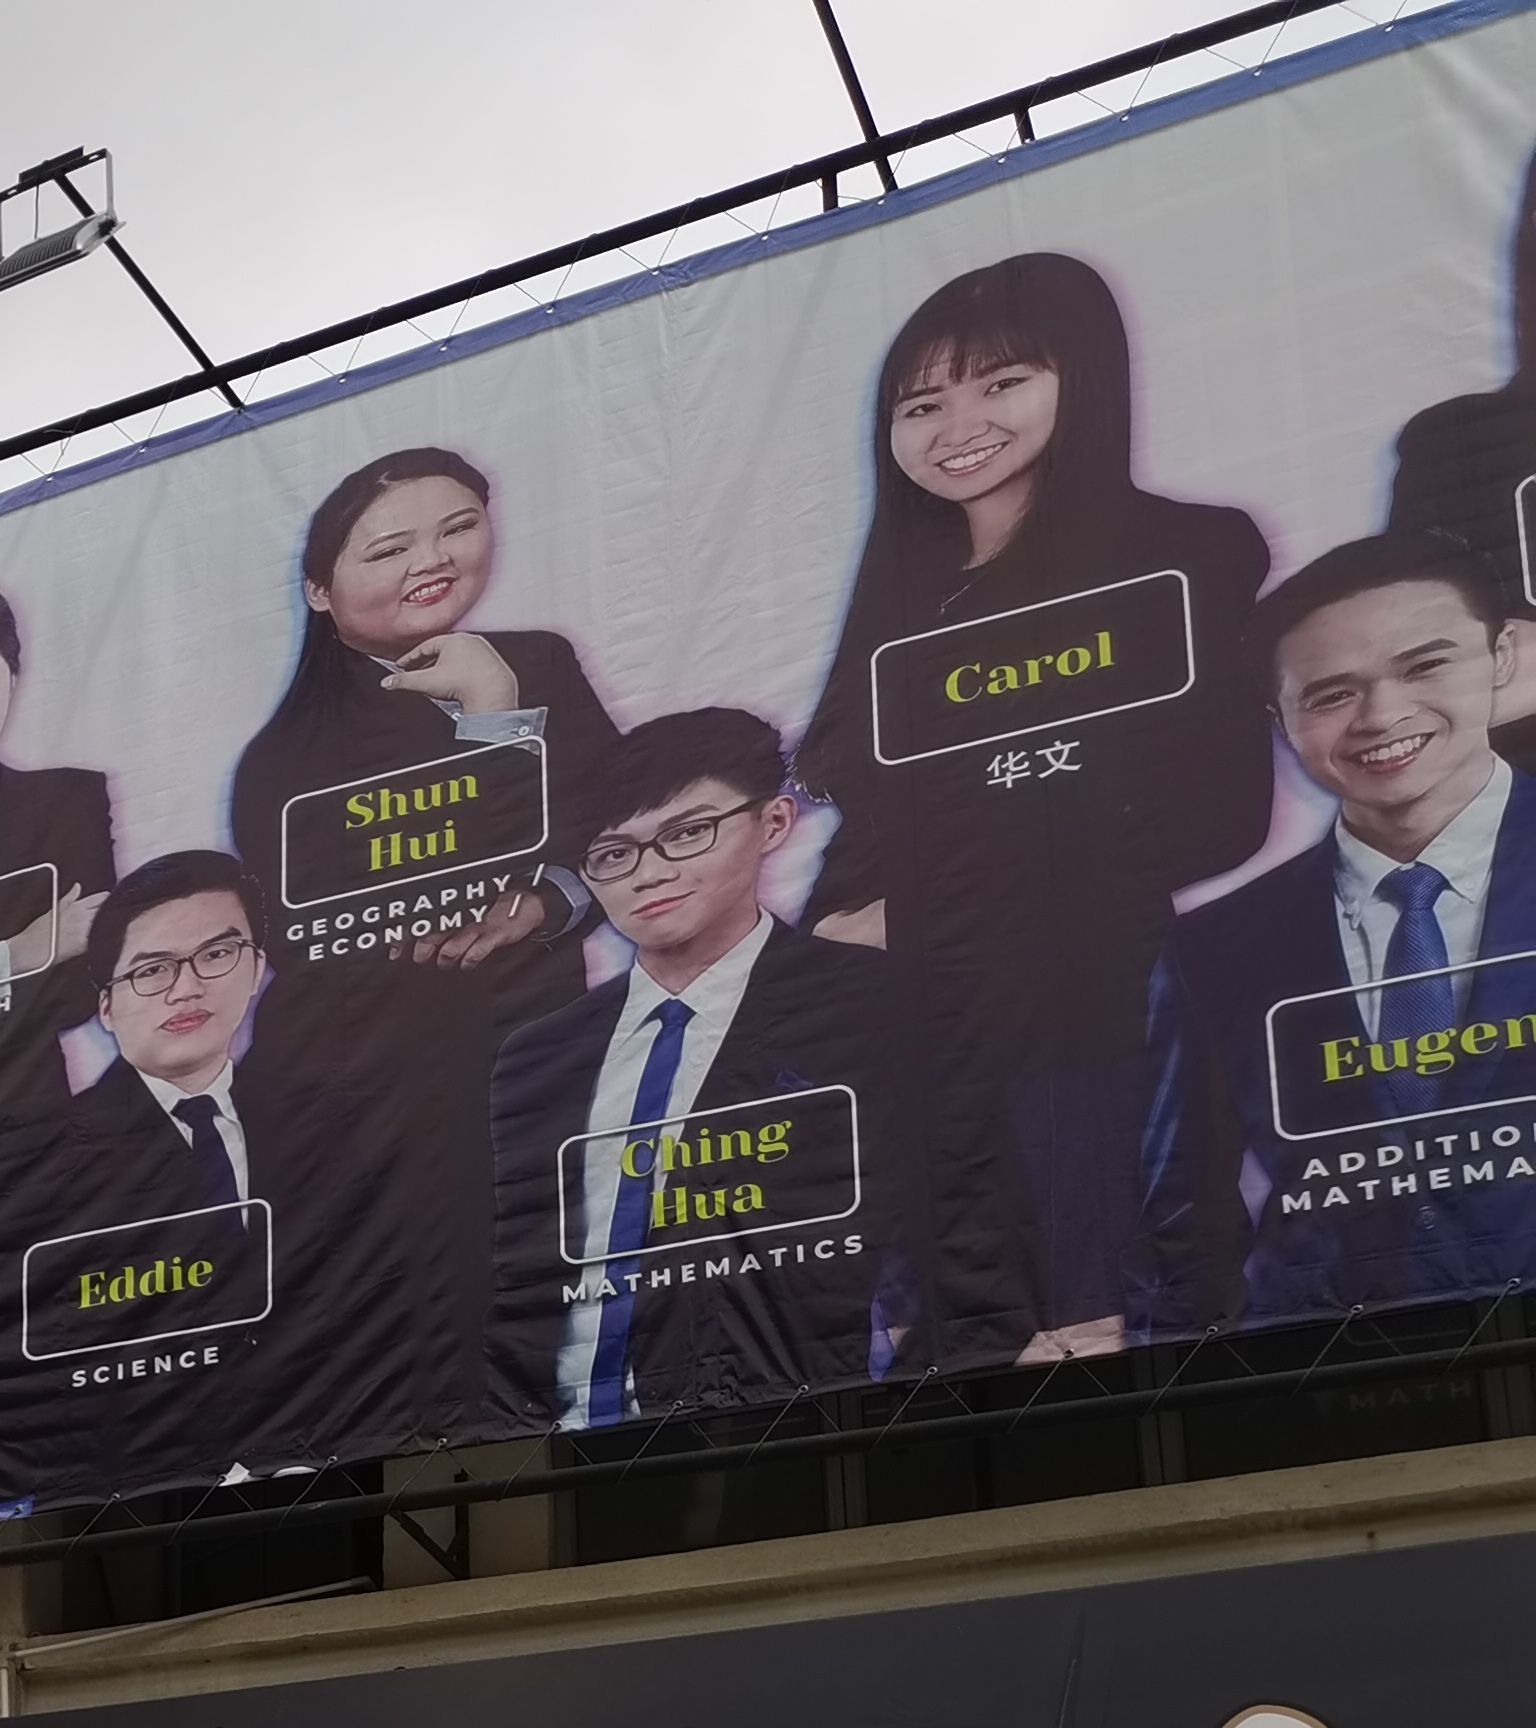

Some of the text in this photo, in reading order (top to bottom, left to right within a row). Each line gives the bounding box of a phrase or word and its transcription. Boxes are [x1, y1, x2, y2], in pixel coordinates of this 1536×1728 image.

[944, 630, 1117, 704] Carol
[986, 740, 1082, 791] 华文
[344, 774, 480, 831] Shun
[367, 820, 458, 873] Hui
[286, 870, 512, 942] GEOGRAPHY
[308, 903, 488, 962] ECONOMY
[620, 1117, 792, 1178] Ching
[1302, 1122, 1536, 1180] ADDITIO
[649, 1179, 766, 1228] Hua
[75, 1255, 214, 1310] Eddie
[561, 1232, 864, 1304] MATHEMATICS
[70, 1345, 221, 1388] SCIENCE
